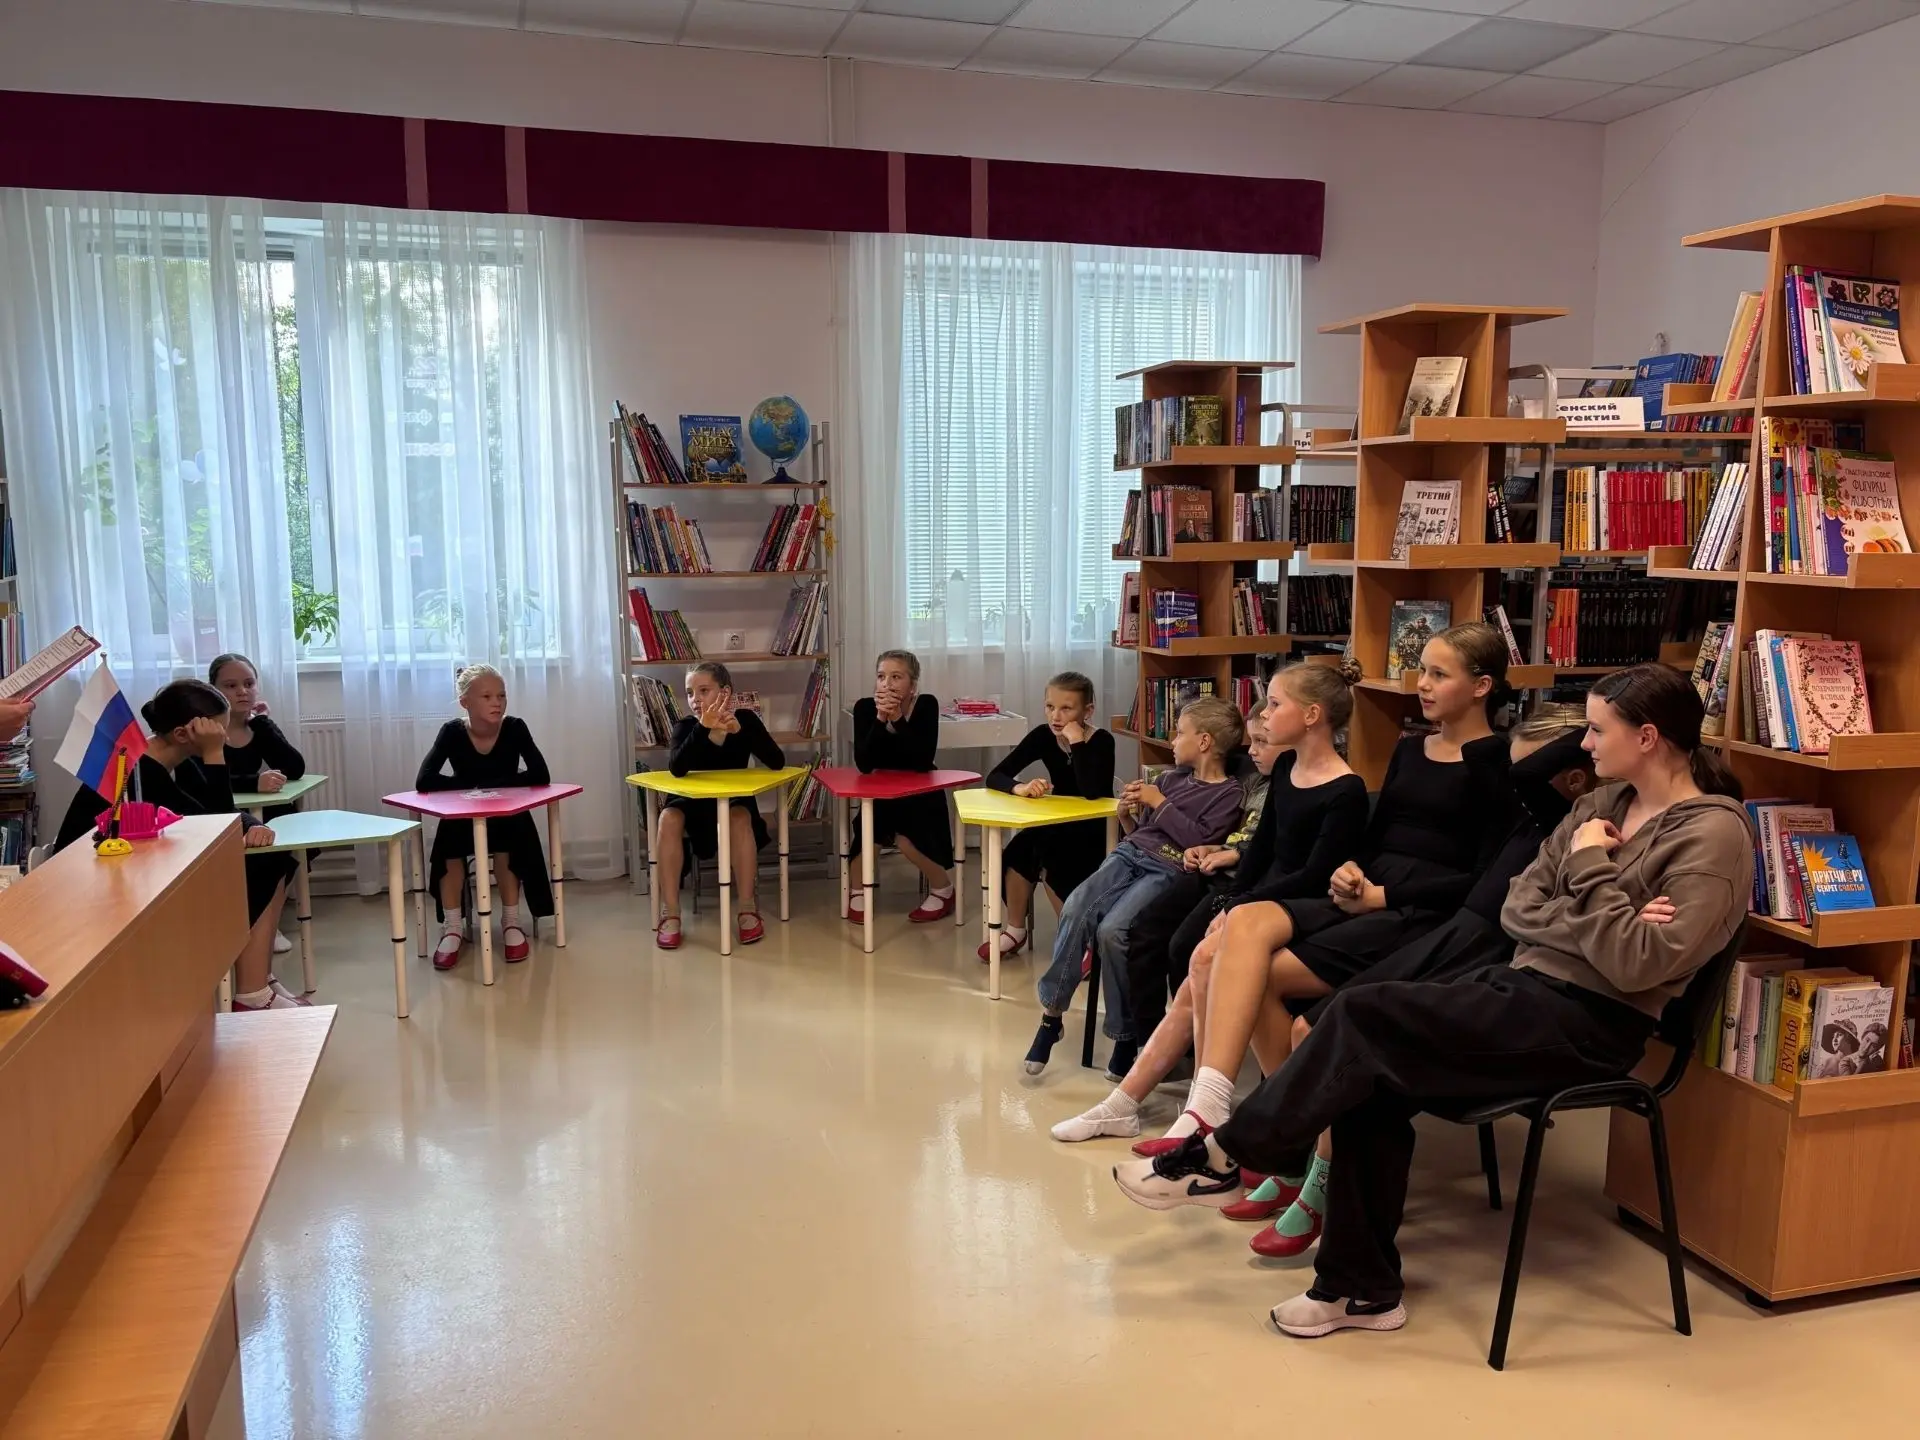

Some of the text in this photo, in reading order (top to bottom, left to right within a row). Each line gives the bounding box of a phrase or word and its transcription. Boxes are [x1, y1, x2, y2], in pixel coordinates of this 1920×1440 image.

[691, 436, 737, 448] МИРА
[1852, 479, 1888, 493] ФИГУРКИ
[1416, 490, 1452, 501] ТРЕТИЙ
[1850, 495, 1895, 509] ЖИВОТНЫХ
[1425, 506, 1448, 516] ТОСТ
[1820, 665, 1839, 676] 1000
[1199, 681, 1213, 693] 100
[1780, 833, 1793, 860] ПРИТЧИ
[1816, 884, 1839, 893] СЕКРЕТ
[1780, 1019, 1800, 1075] ВУЛЬФ
